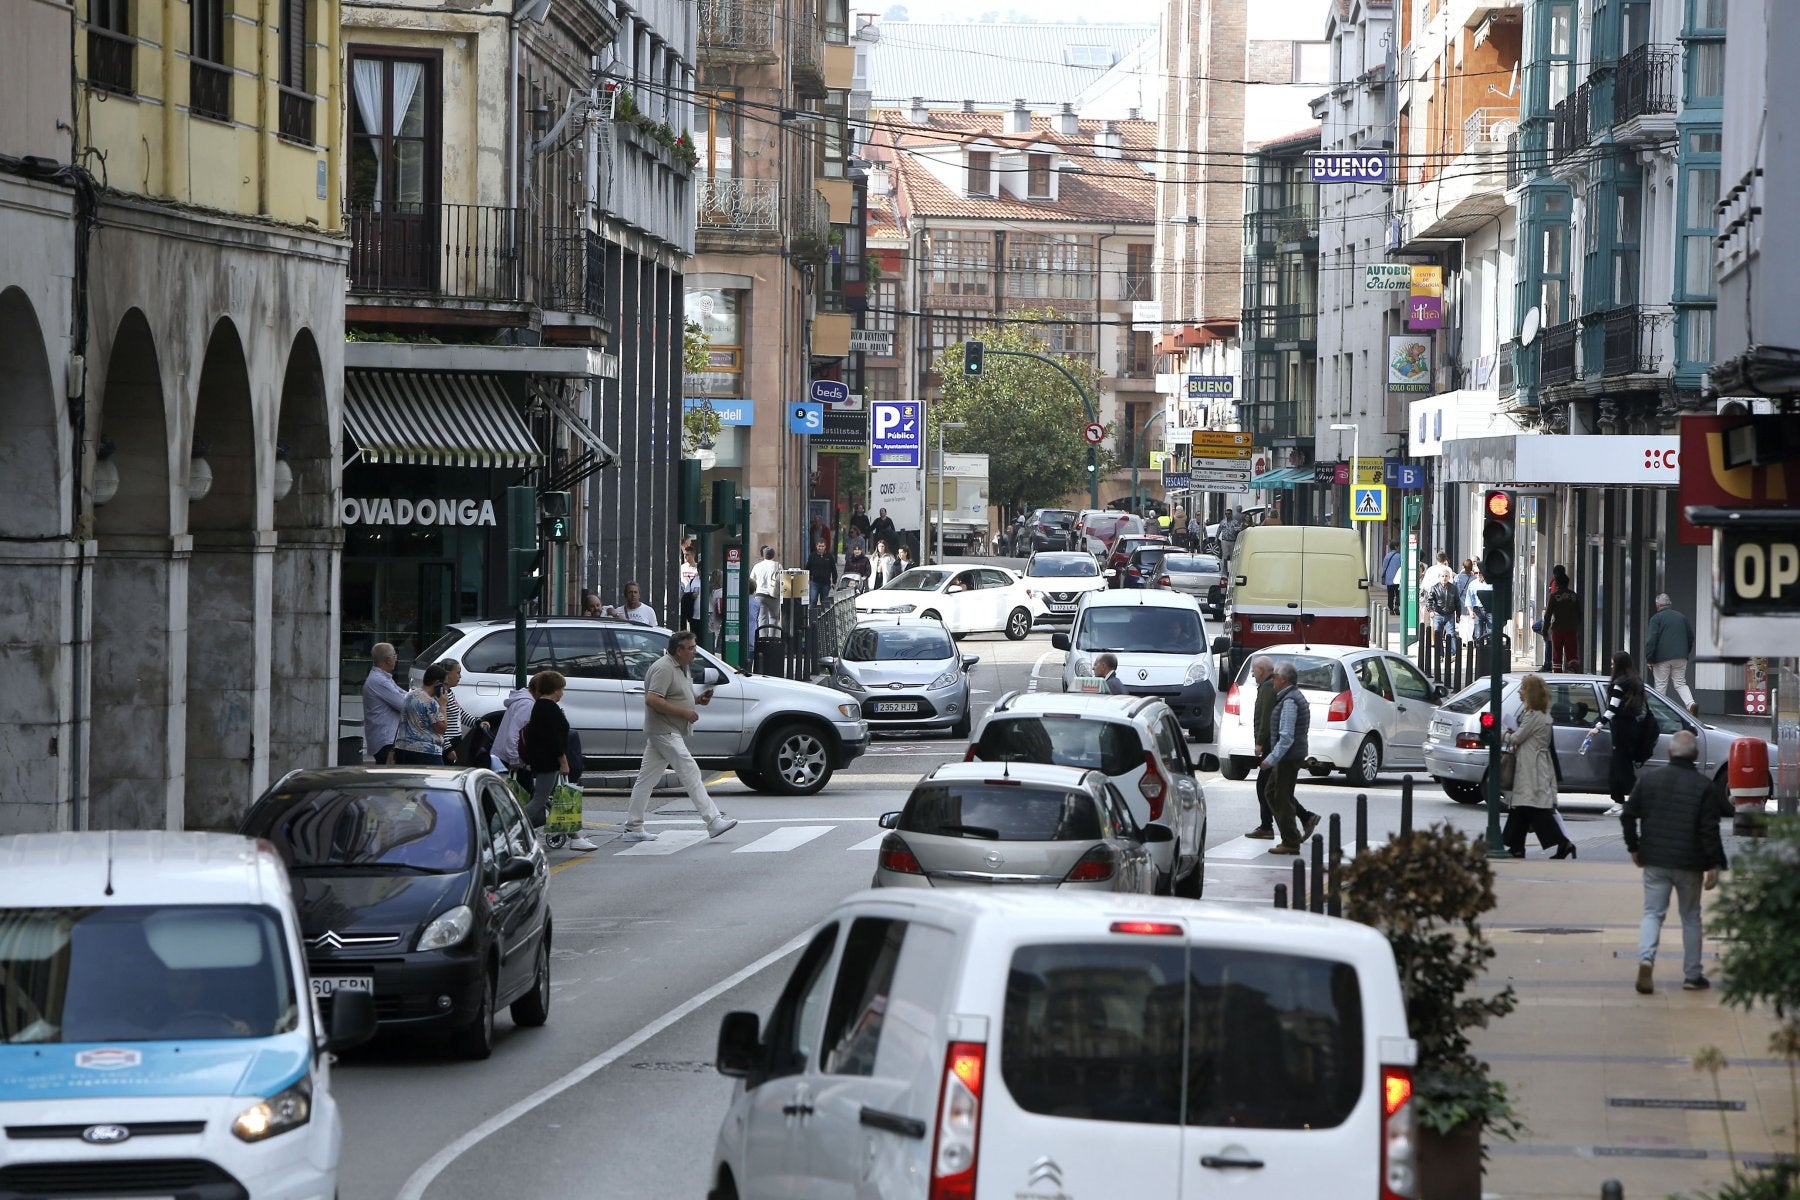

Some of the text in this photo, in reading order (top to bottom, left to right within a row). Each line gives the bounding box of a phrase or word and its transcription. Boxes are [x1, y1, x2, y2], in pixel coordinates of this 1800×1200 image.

[1314, 157, 1383, 177] BUENO
[1190, 381, 1233, 393] BUENO
[1406, 384, 1430, 392] GRUPOS
[875, 406, 901, 440] P
[887, 432, 915, 440] Público
[1663, 450, 1680, 469] C
[341, 498, 497, 526] OVADONGA
[1734, 543, 1800, 599] OP
[880, 703, 917, 711] 2352 HJZ
